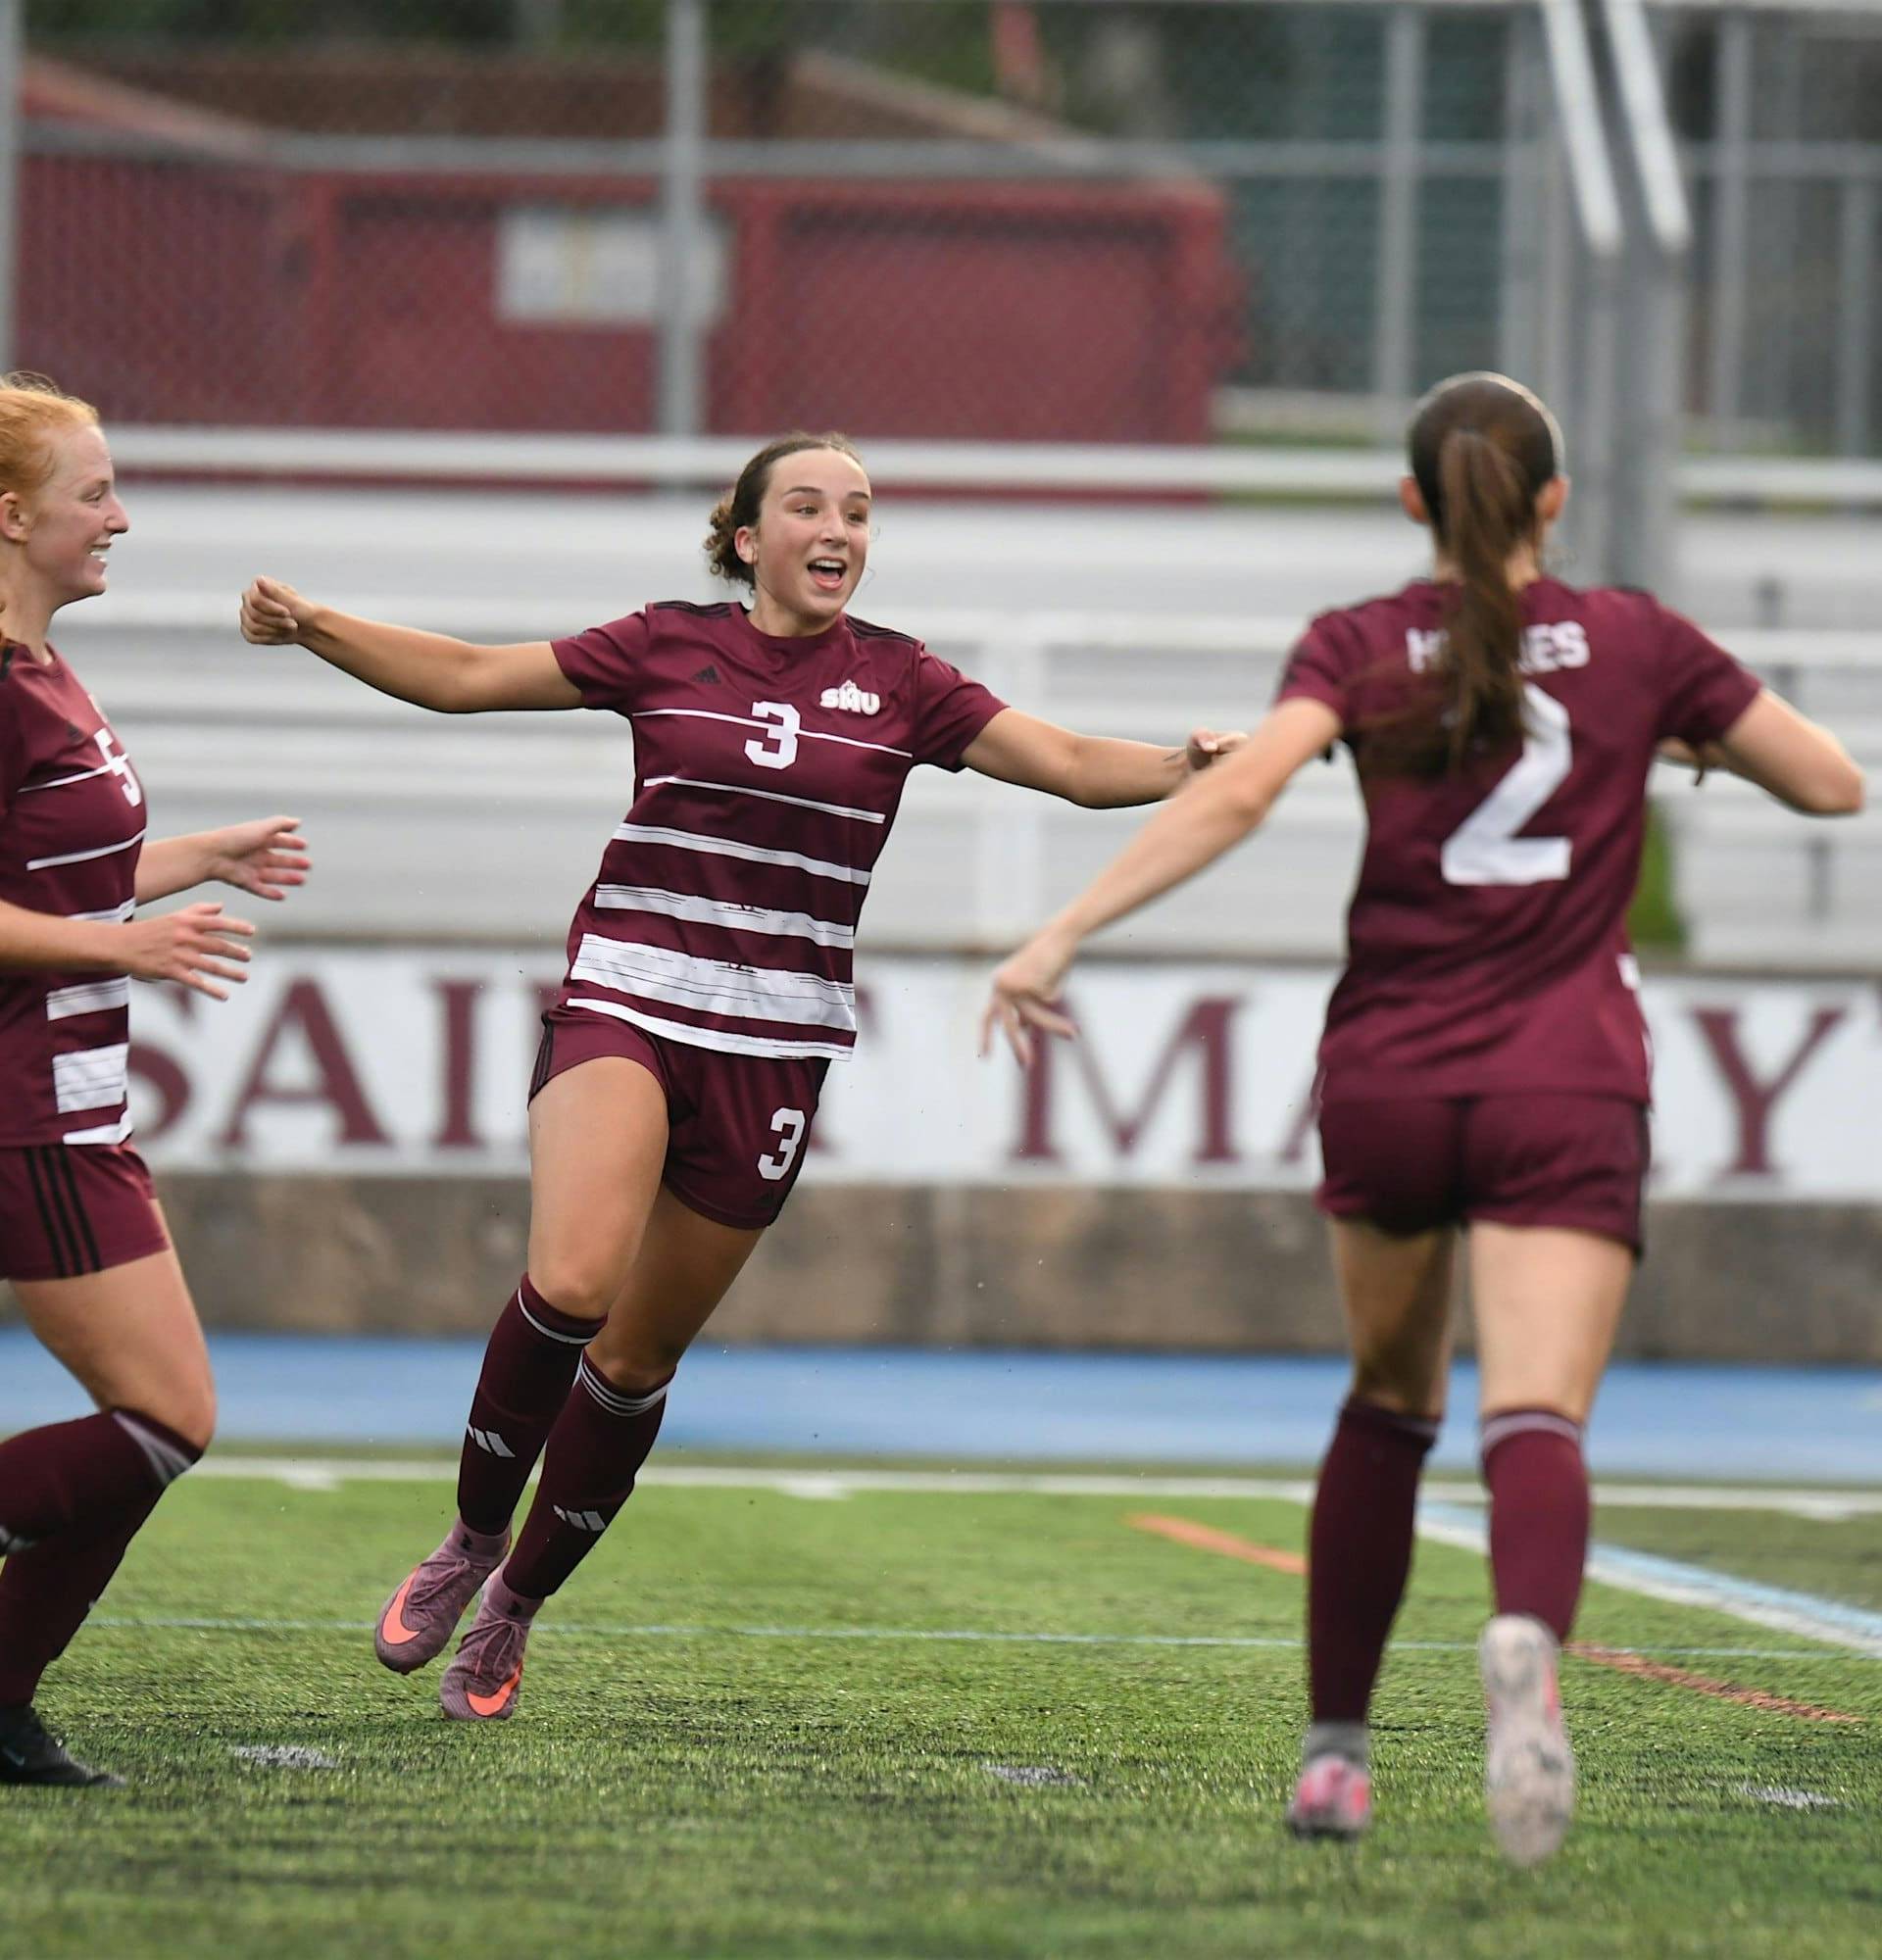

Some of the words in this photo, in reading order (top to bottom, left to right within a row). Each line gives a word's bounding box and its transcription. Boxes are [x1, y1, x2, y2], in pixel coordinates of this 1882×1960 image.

[93, 727, 142, 808] 5
[744, 701, 801, 770] 3
[1441, 682, 1573, 886] 2
[1010, 990, 1849, 1178] MY
[758, 1106, 806, 1181] 3
